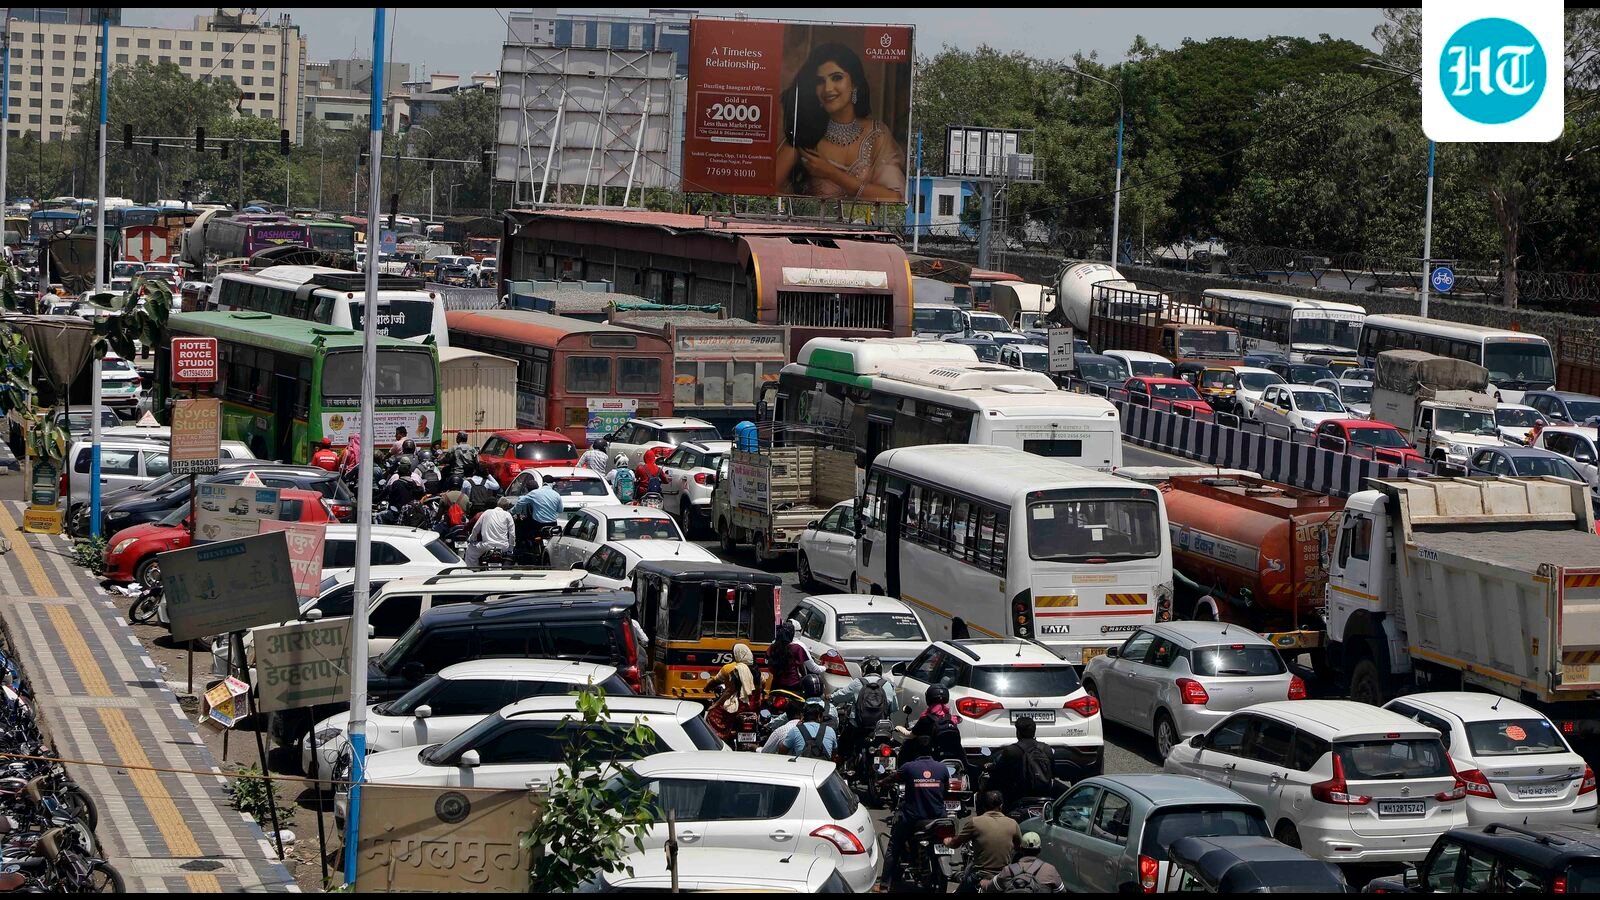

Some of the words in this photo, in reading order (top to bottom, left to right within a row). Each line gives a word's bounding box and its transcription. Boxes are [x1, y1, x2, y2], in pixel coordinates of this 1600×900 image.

[711, 47, 719, 55] A
[722, 46, 763, 57] Timeless
[705, 57, 766, 71] Relationship...
[724, 96, 740, 104] Gold
[706, 167, 731, 176] 77699
[734, 169, 756, 177] 81010
[257, 231, 301, 239] DASHMESH
[180, 342, 212, 350] HOTEL
[178, 359, 214, 367] STUDIO
[175, 407, 217, 420] Royce
[175, 420, 217, 431] Studio
[172, 467, 189, 475] 9175
[212, 487, 226, 495] LIC
[1424, 549, 1439, 561] TATA
[1042, 625, 1069, 633] TATA
[266, 626, 343, 654] आराध्या
[1383, 804, 1424, 813] MH12RT5742
